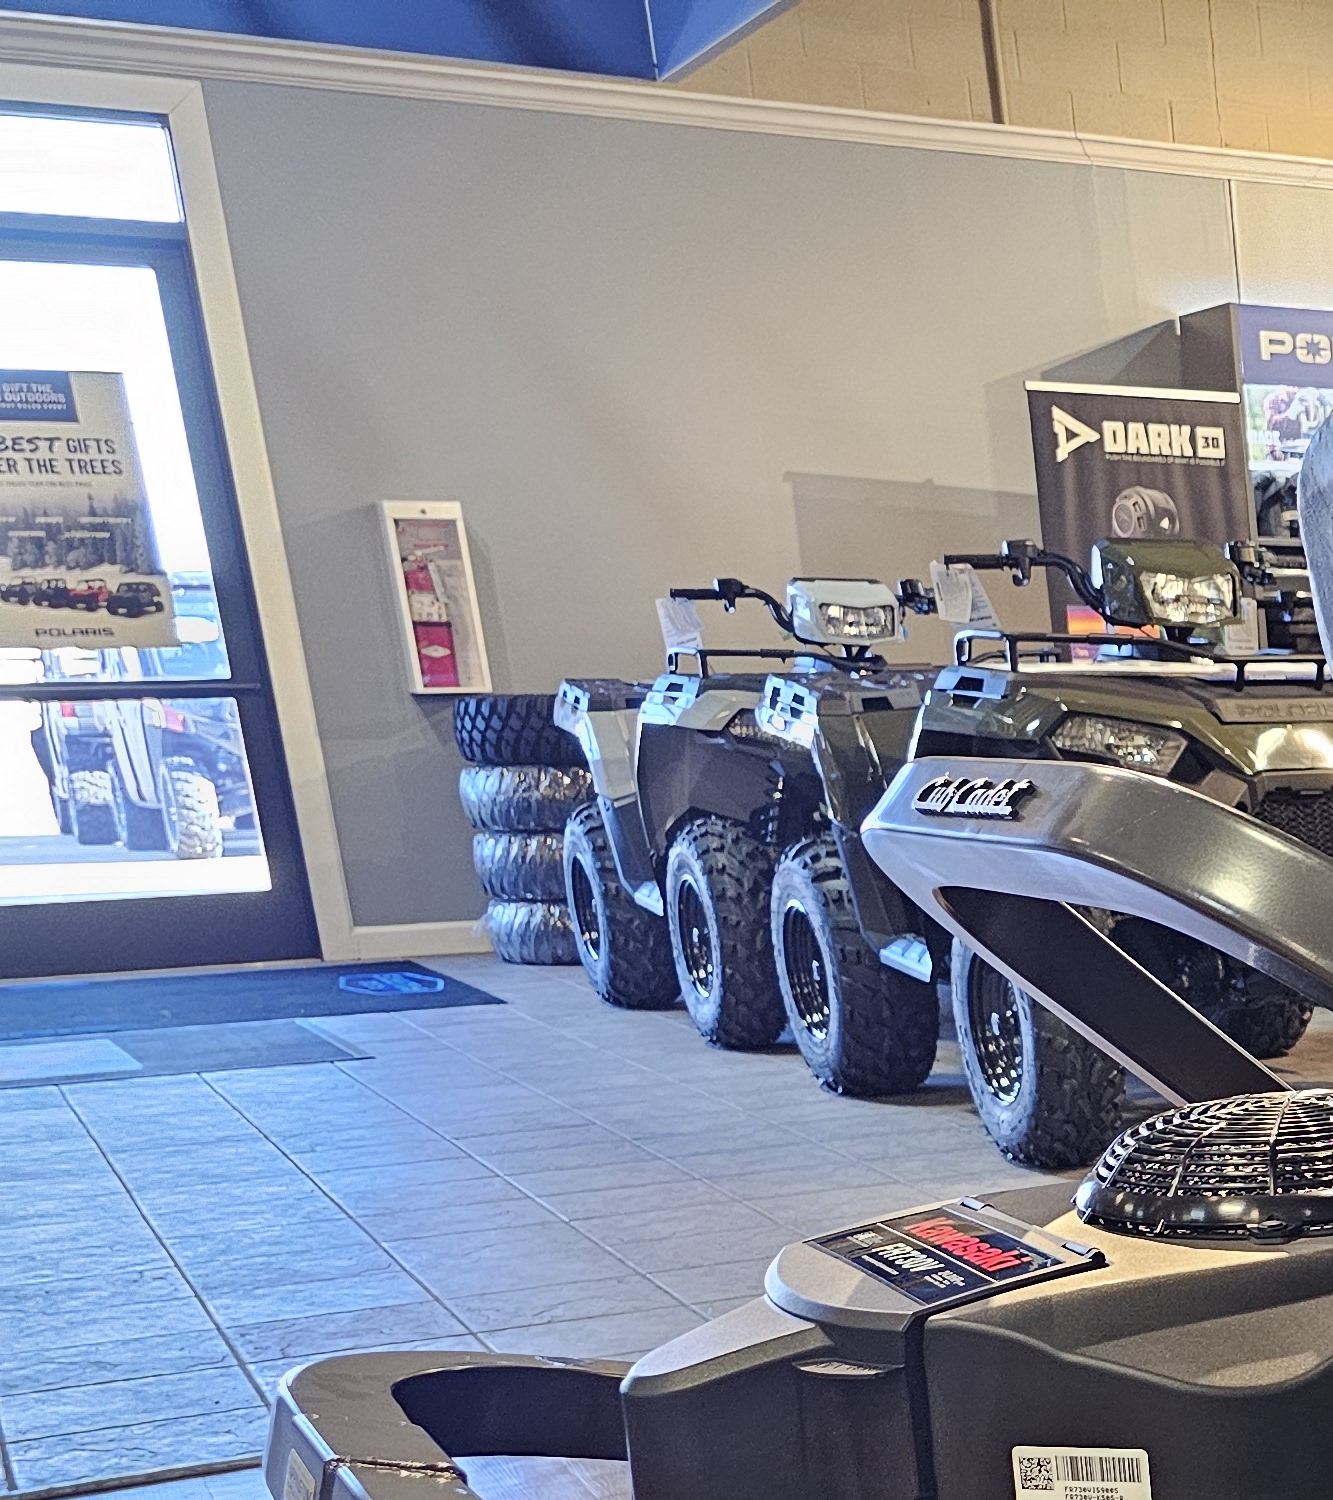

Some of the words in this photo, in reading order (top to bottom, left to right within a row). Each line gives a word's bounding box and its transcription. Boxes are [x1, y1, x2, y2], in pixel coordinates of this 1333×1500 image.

[66, 438, 116, 455] GIFTS
[1102, 420, 1194, 457] DARK
[24, 458, 61, 475] THE
[65, 458, 123, 475] TREES
[34, 627, 115, 638] POLARIS
[903, 1216, 1034, 1273] Kawasaki
[871, 1242, 946, 1273] FR730V
